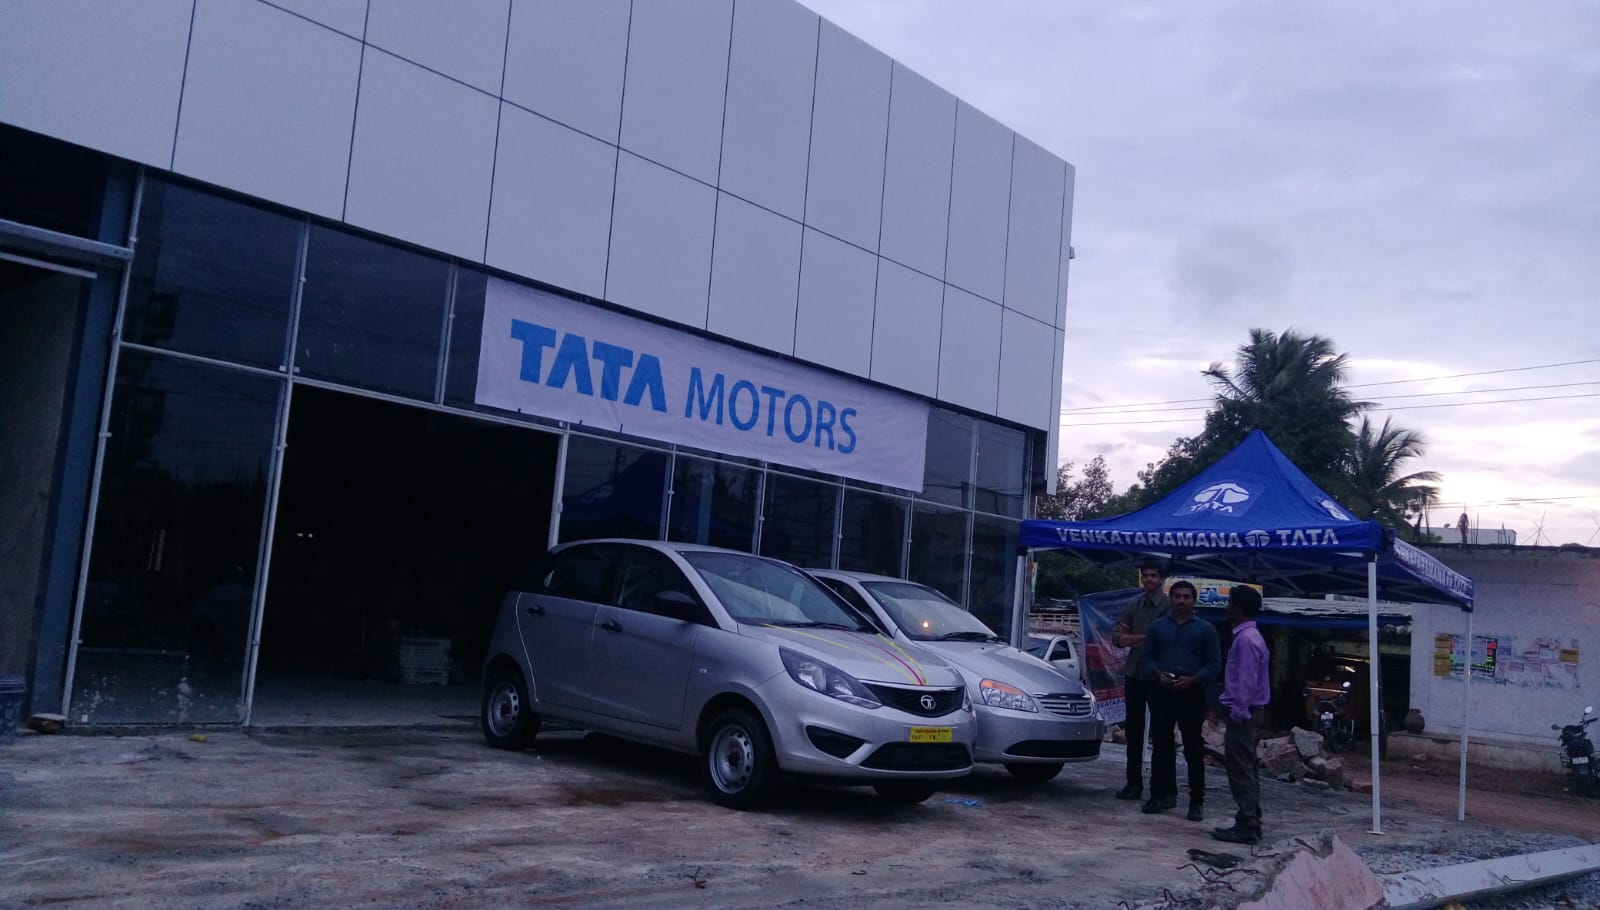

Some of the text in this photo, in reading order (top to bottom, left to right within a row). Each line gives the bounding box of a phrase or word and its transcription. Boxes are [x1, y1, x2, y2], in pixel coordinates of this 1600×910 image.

[511, 318, 857, 454] TATA MOTORS
[1190, 501, 1233, 513] TATA
[1056, 527, 1339, 549] VENKATARAMANA TATA
